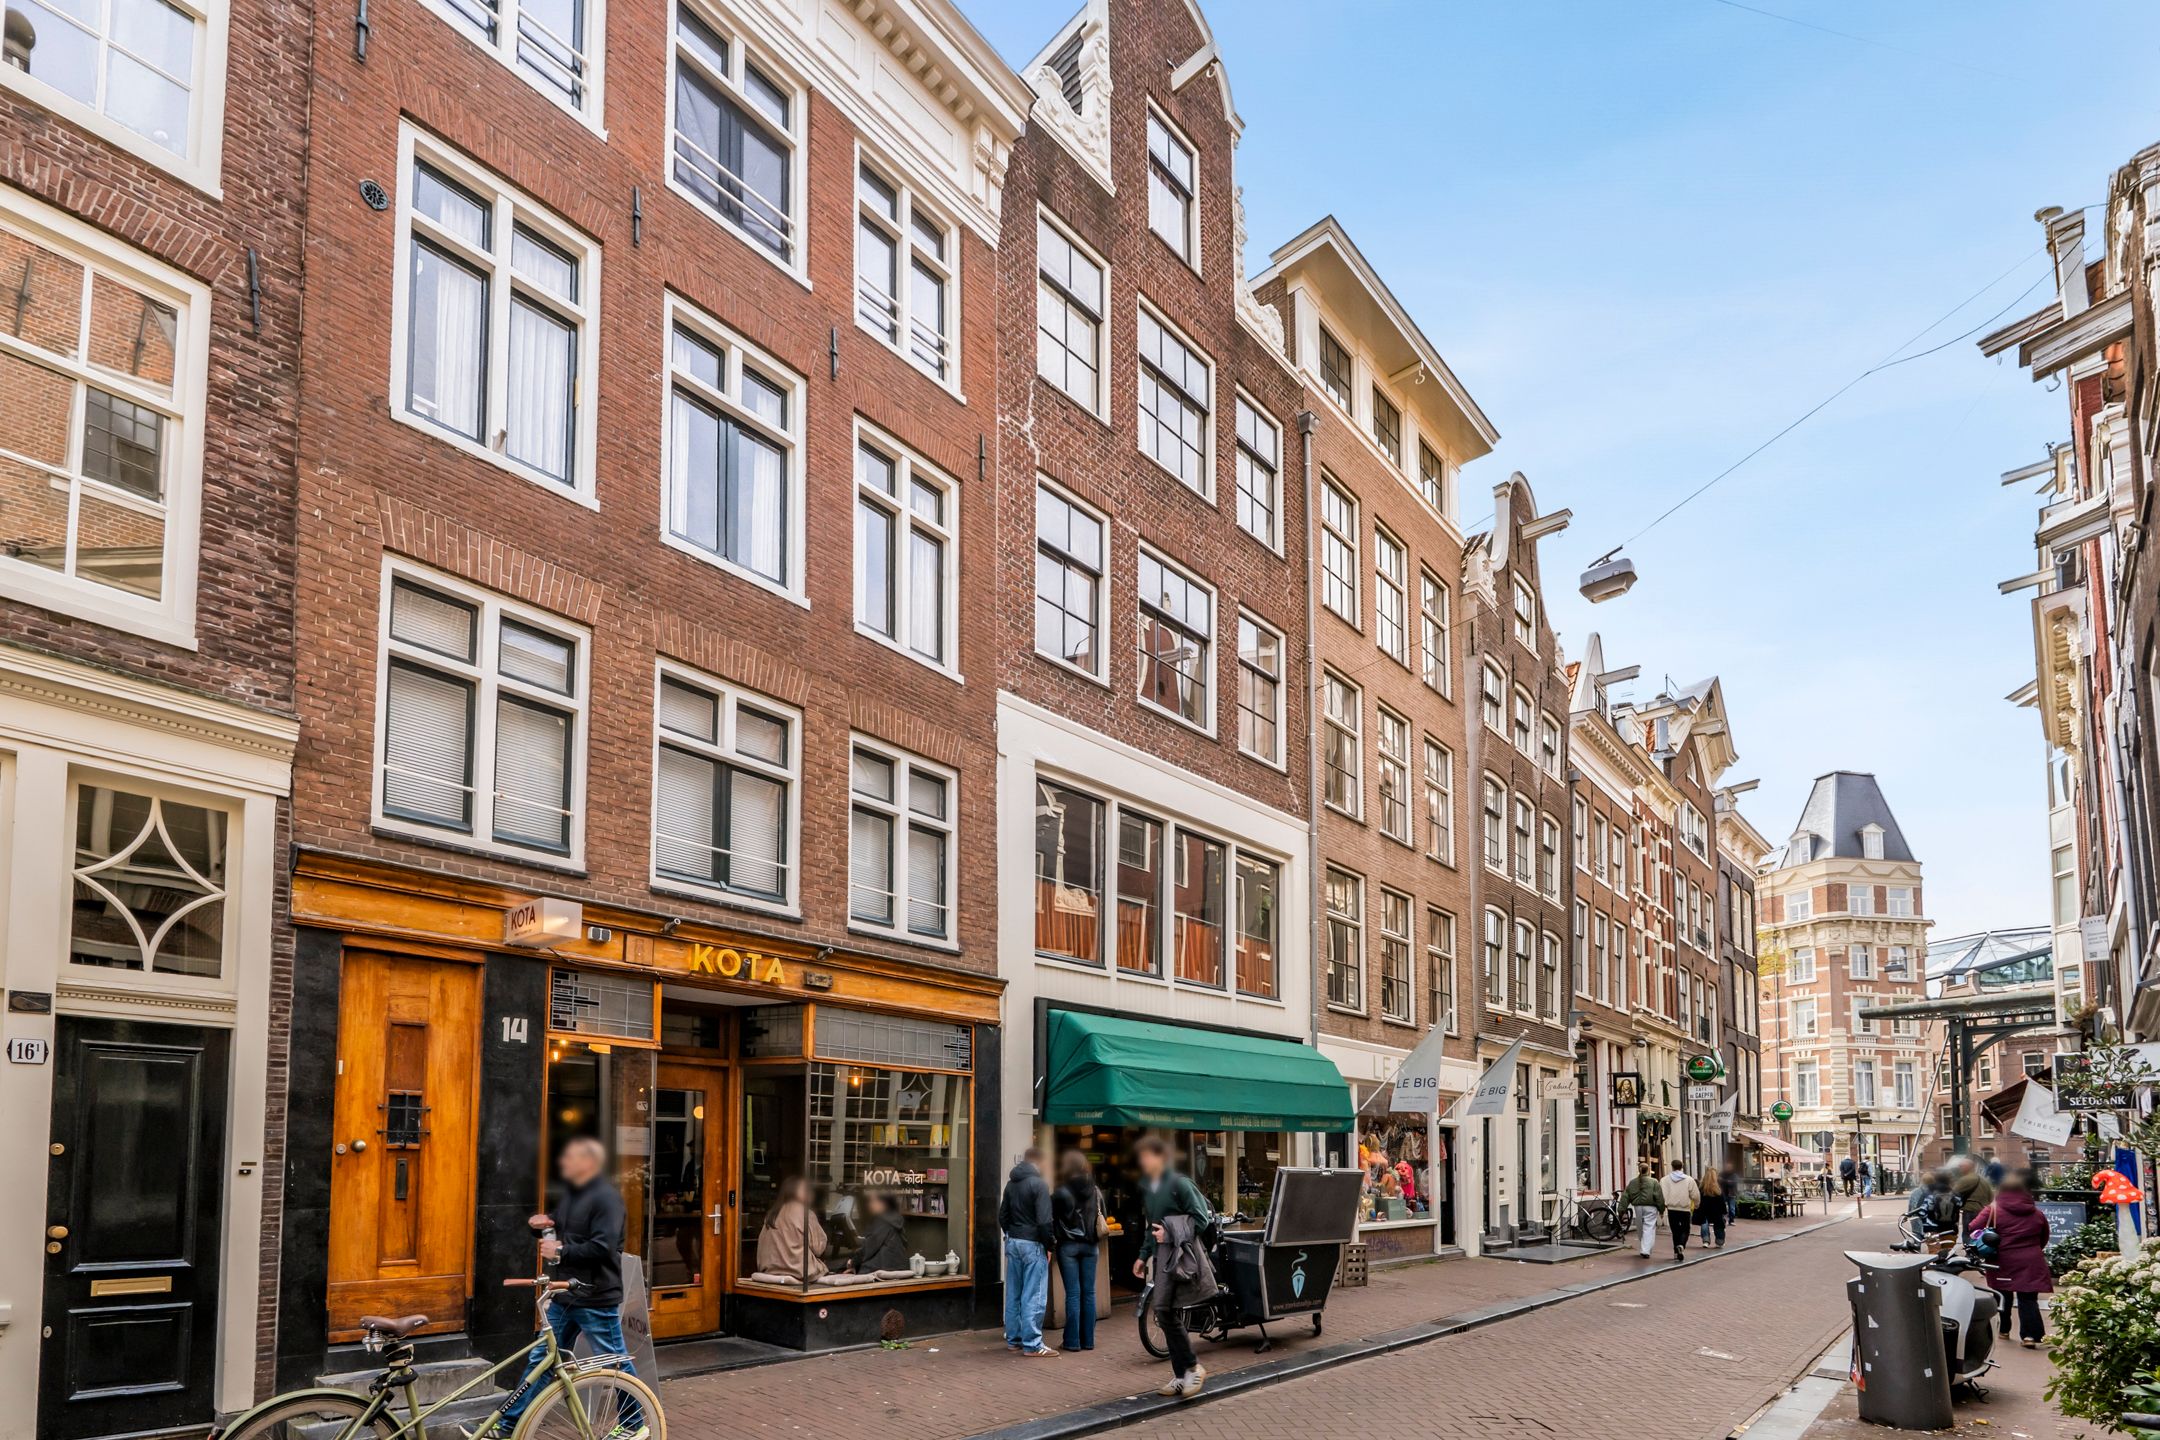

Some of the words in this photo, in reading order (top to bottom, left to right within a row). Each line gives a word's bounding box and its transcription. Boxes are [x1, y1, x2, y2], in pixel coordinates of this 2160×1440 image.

[511, 905, 536, 930] KOTA
[690, 943, 785, 984] KOTA
[502, 1016, 528, 1043] 14
[1396, 1078, 1410, 1089] LE
[1413, 1077, 1437, 1089] BIG
[1544, 1081, 1575, 1092] Gabriel
[1475, 1088, 1486, 1098] LE
[1488, 1086, 1506, 1096] BIG
[2023, 1118, 2063, 1132] TRIBECA
[863, 1170, 901, 1185] KOTA
[904, 1169, 923, 1185] कोटा
